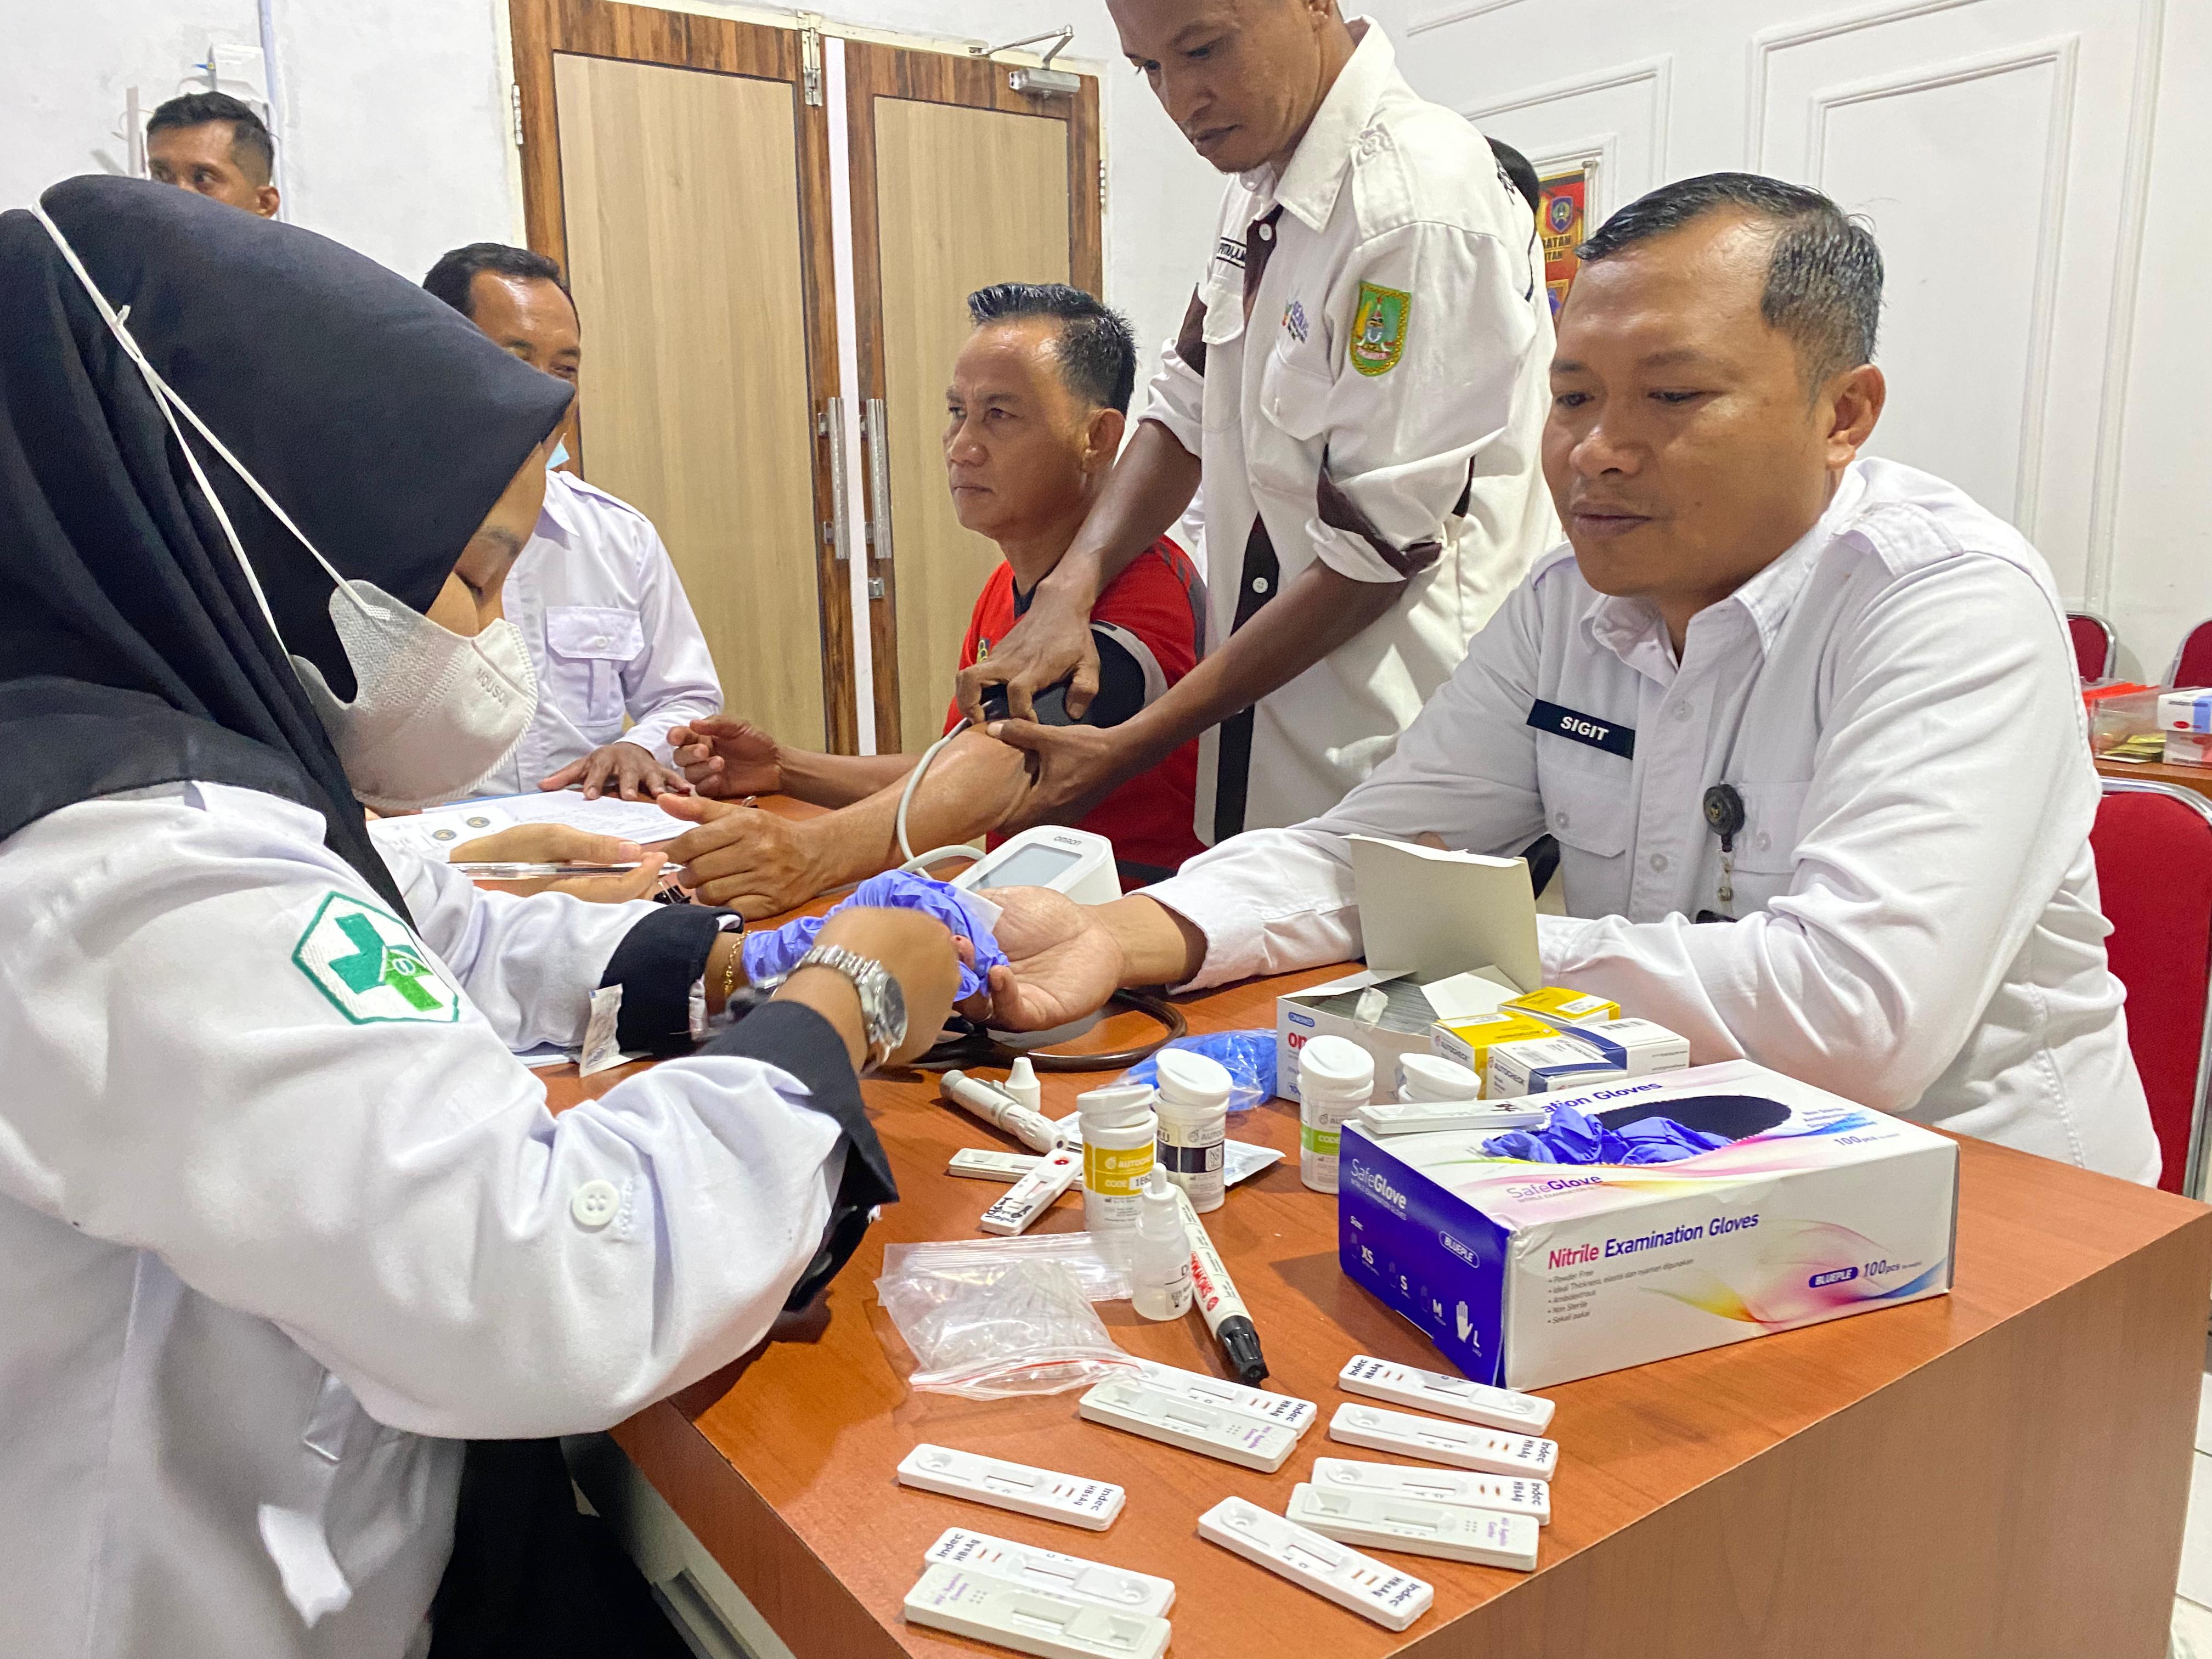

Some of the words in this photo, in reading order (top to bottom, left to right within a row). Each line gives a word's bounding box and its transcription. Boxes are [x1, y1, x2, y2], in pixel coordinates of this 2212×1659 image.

[1560, 716, 1609, 741] SIGIT
[1593, 1082, 1663, 1100] Gloves
[1351, 1158, 1407, 1210] SafeGlove
[1506, 1176, 1603, 1198] SafeGlove
[1548, 1243, 1600, 1269] Nitrile
[1604, 1224, 1703, 1258] Examination
[1708, 1213, 1759, 1236] Gloves
[1361, 1245, 1374, 1265] XS
[1400, 1274, 1408, 1290] S
[1815, 1268, 1853, 1285] BLUEPLE
[1433, 1299, 1442, 1317] M
[1473, 1330, 1480, 1348] L
[1348, 1359, 1368, 1376] Indec
[1286, 1403, 1308, 1422] Indec
[1536, 1442, 1553, 1464] Indec
[1090, 1488, 1114, 1511] Indec
[1530, 1482, 1543, 1506] Indec
[935, 1533, 964, 1559] Indec
[952, 1538, 981, 1562] HBsAg
[1389, 1582, 1421, 1607] Indec
